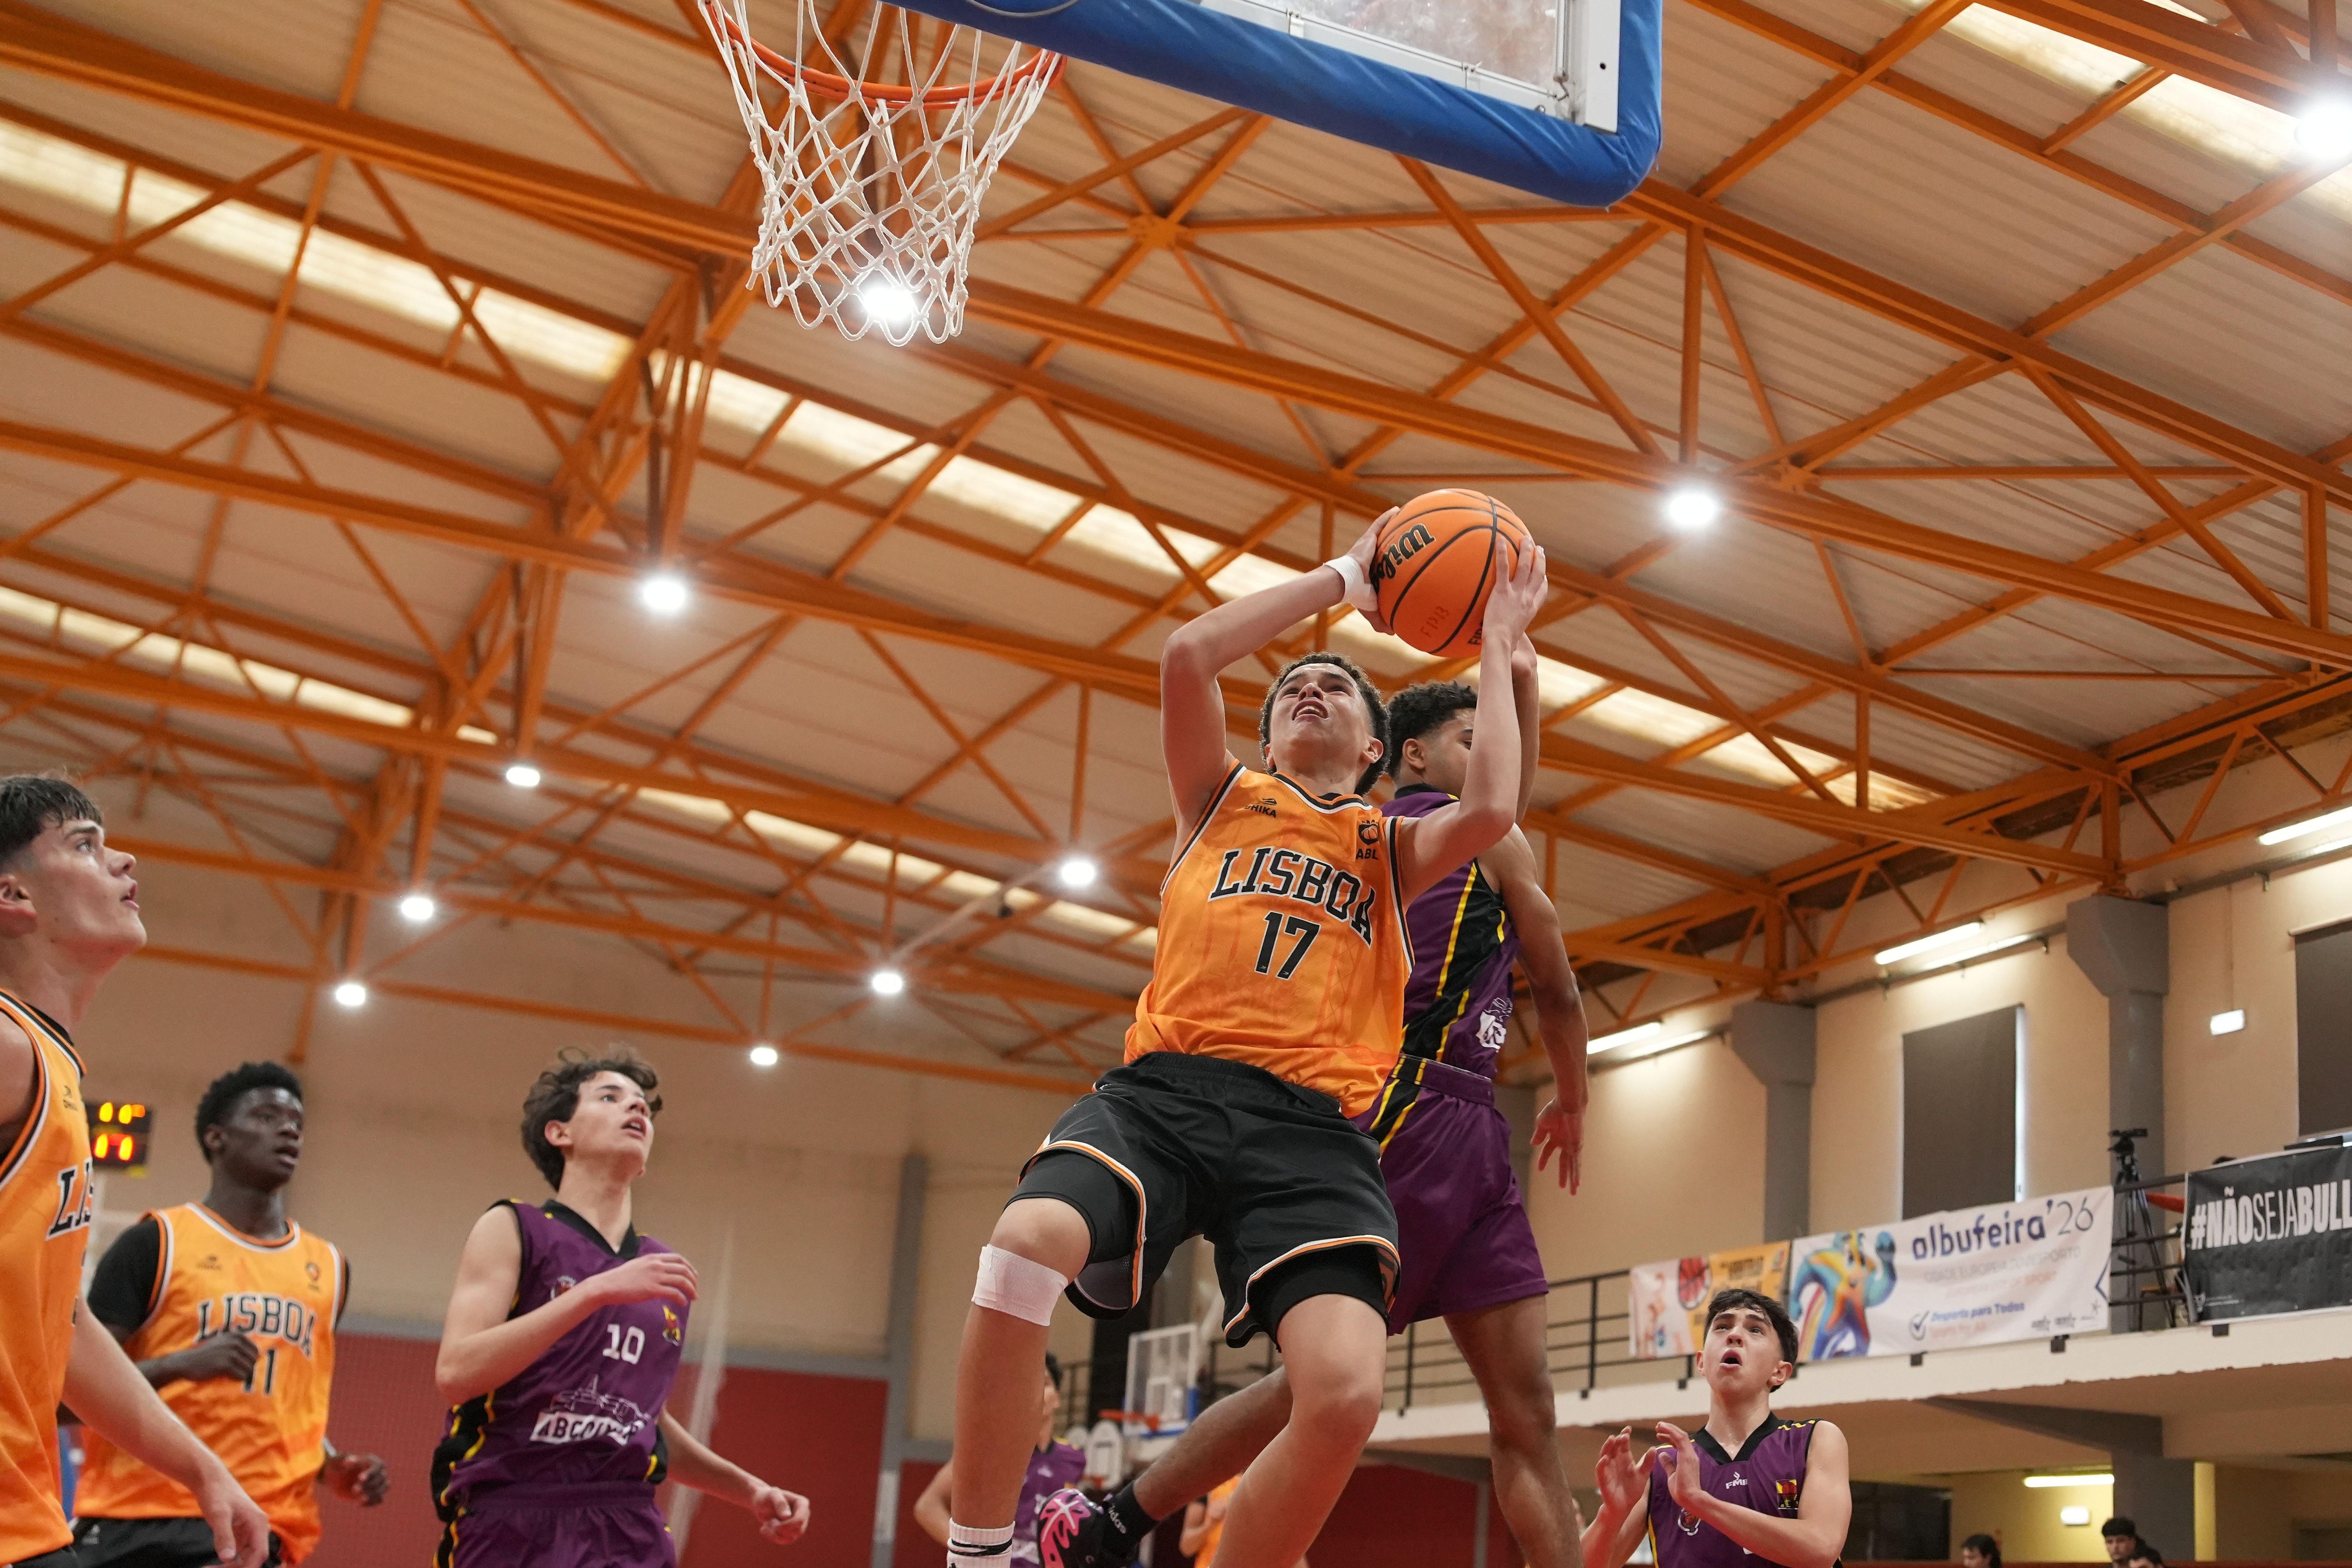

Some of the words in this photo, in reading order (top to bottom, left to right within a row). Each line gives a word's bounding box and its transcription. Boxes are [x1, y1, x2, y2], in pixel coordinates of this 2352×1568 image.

[1356, 848, 1379, 860] ABL
[1207, 846, 1374, 948] LISBOA
[1254, 910, 1320, 981] 17
[195, 1291, 318, 1360] LISBOA
[602, 1323, 645, 1364] 10
